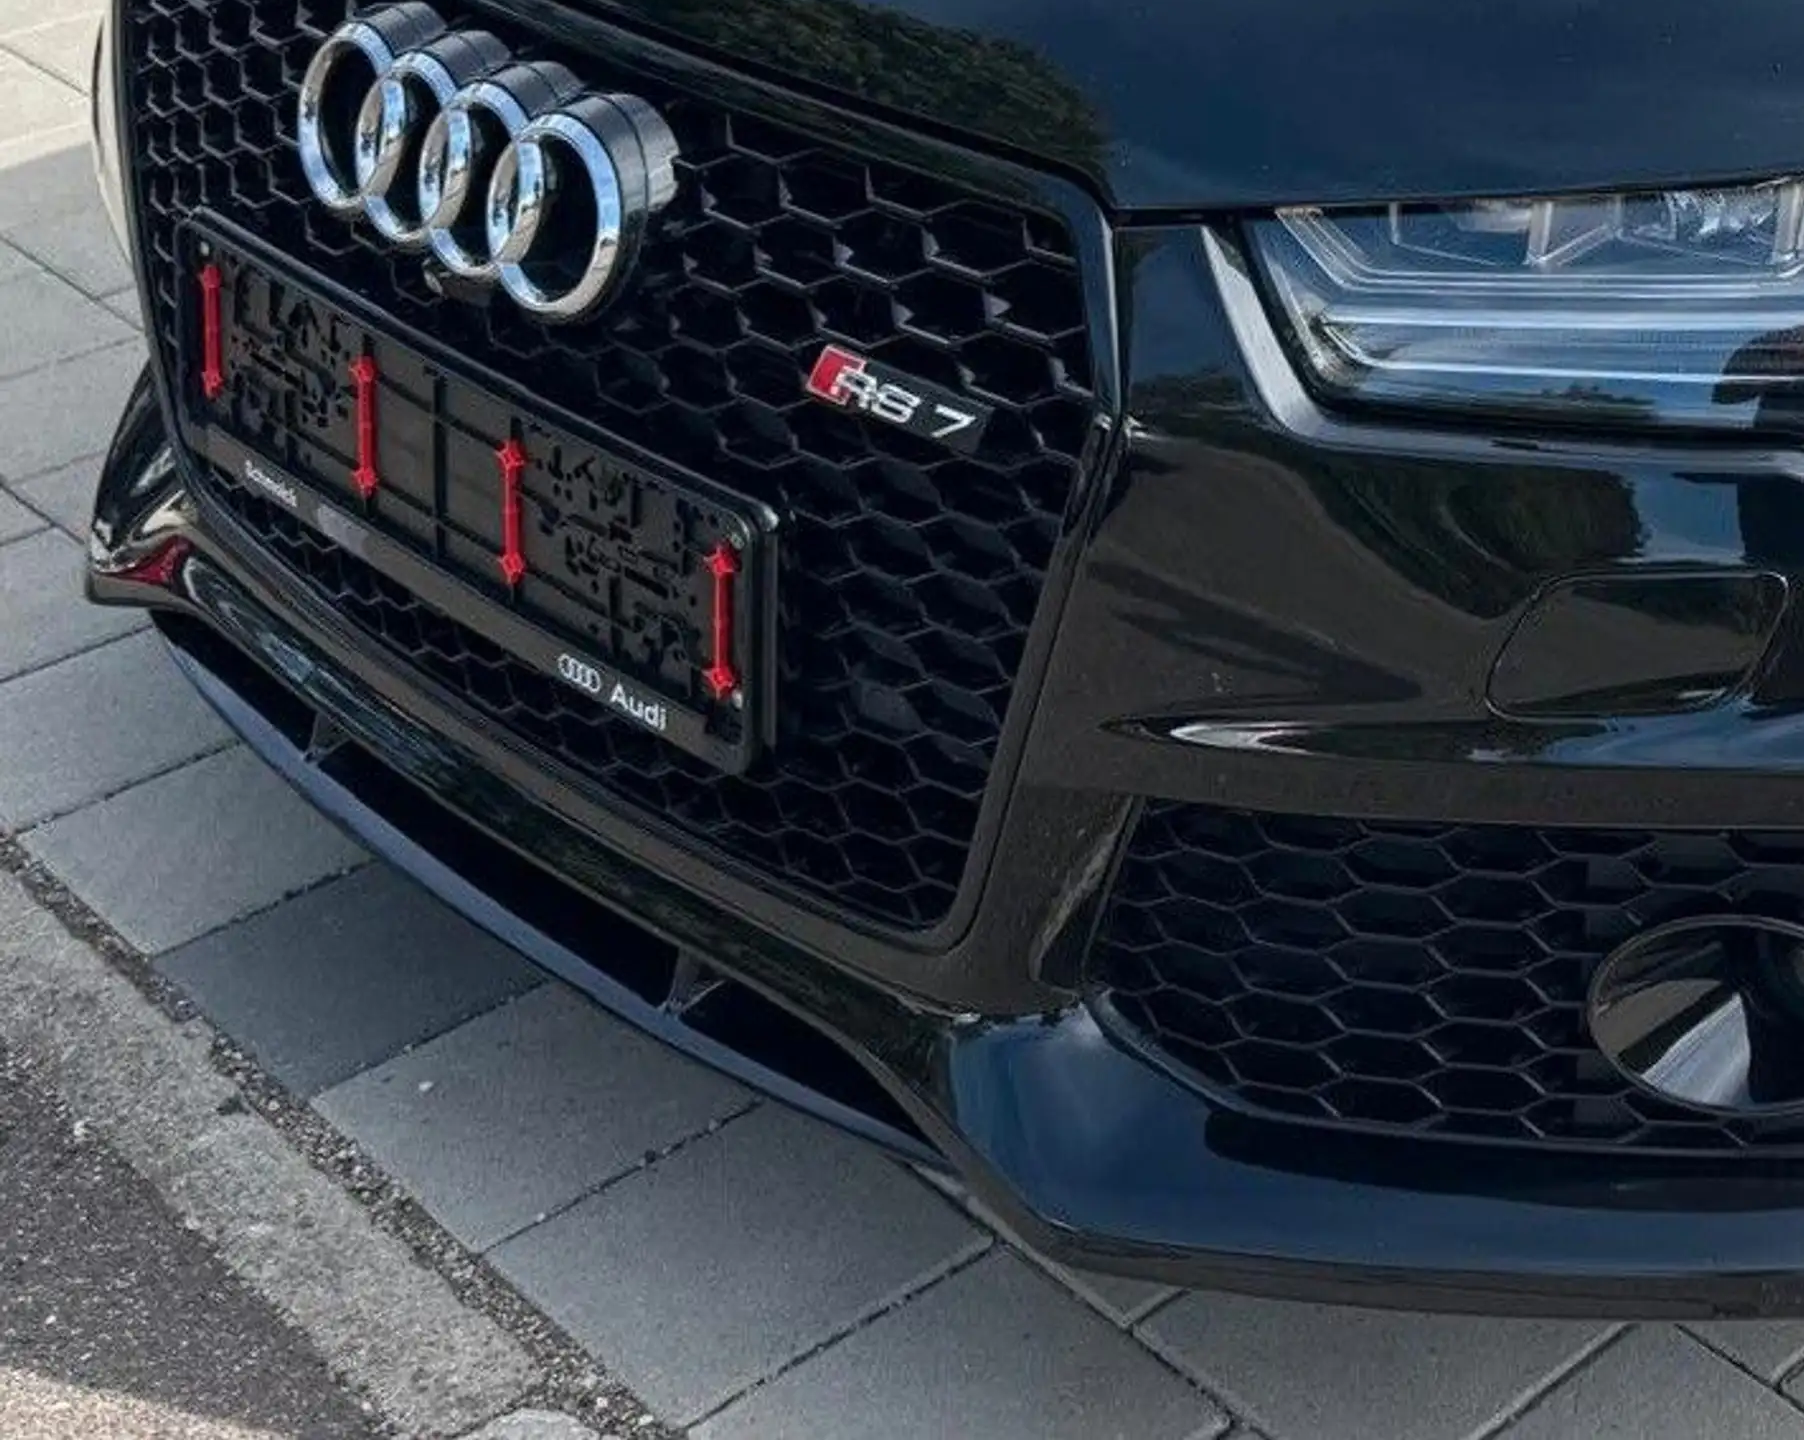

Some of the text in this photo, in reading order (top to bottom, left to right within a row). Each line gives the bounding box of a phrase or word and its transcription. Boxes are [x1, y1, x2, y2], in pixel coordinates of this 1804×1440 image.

[829, 364, 977, 439] RS 7
[609, 683, 668, 731] Audi
